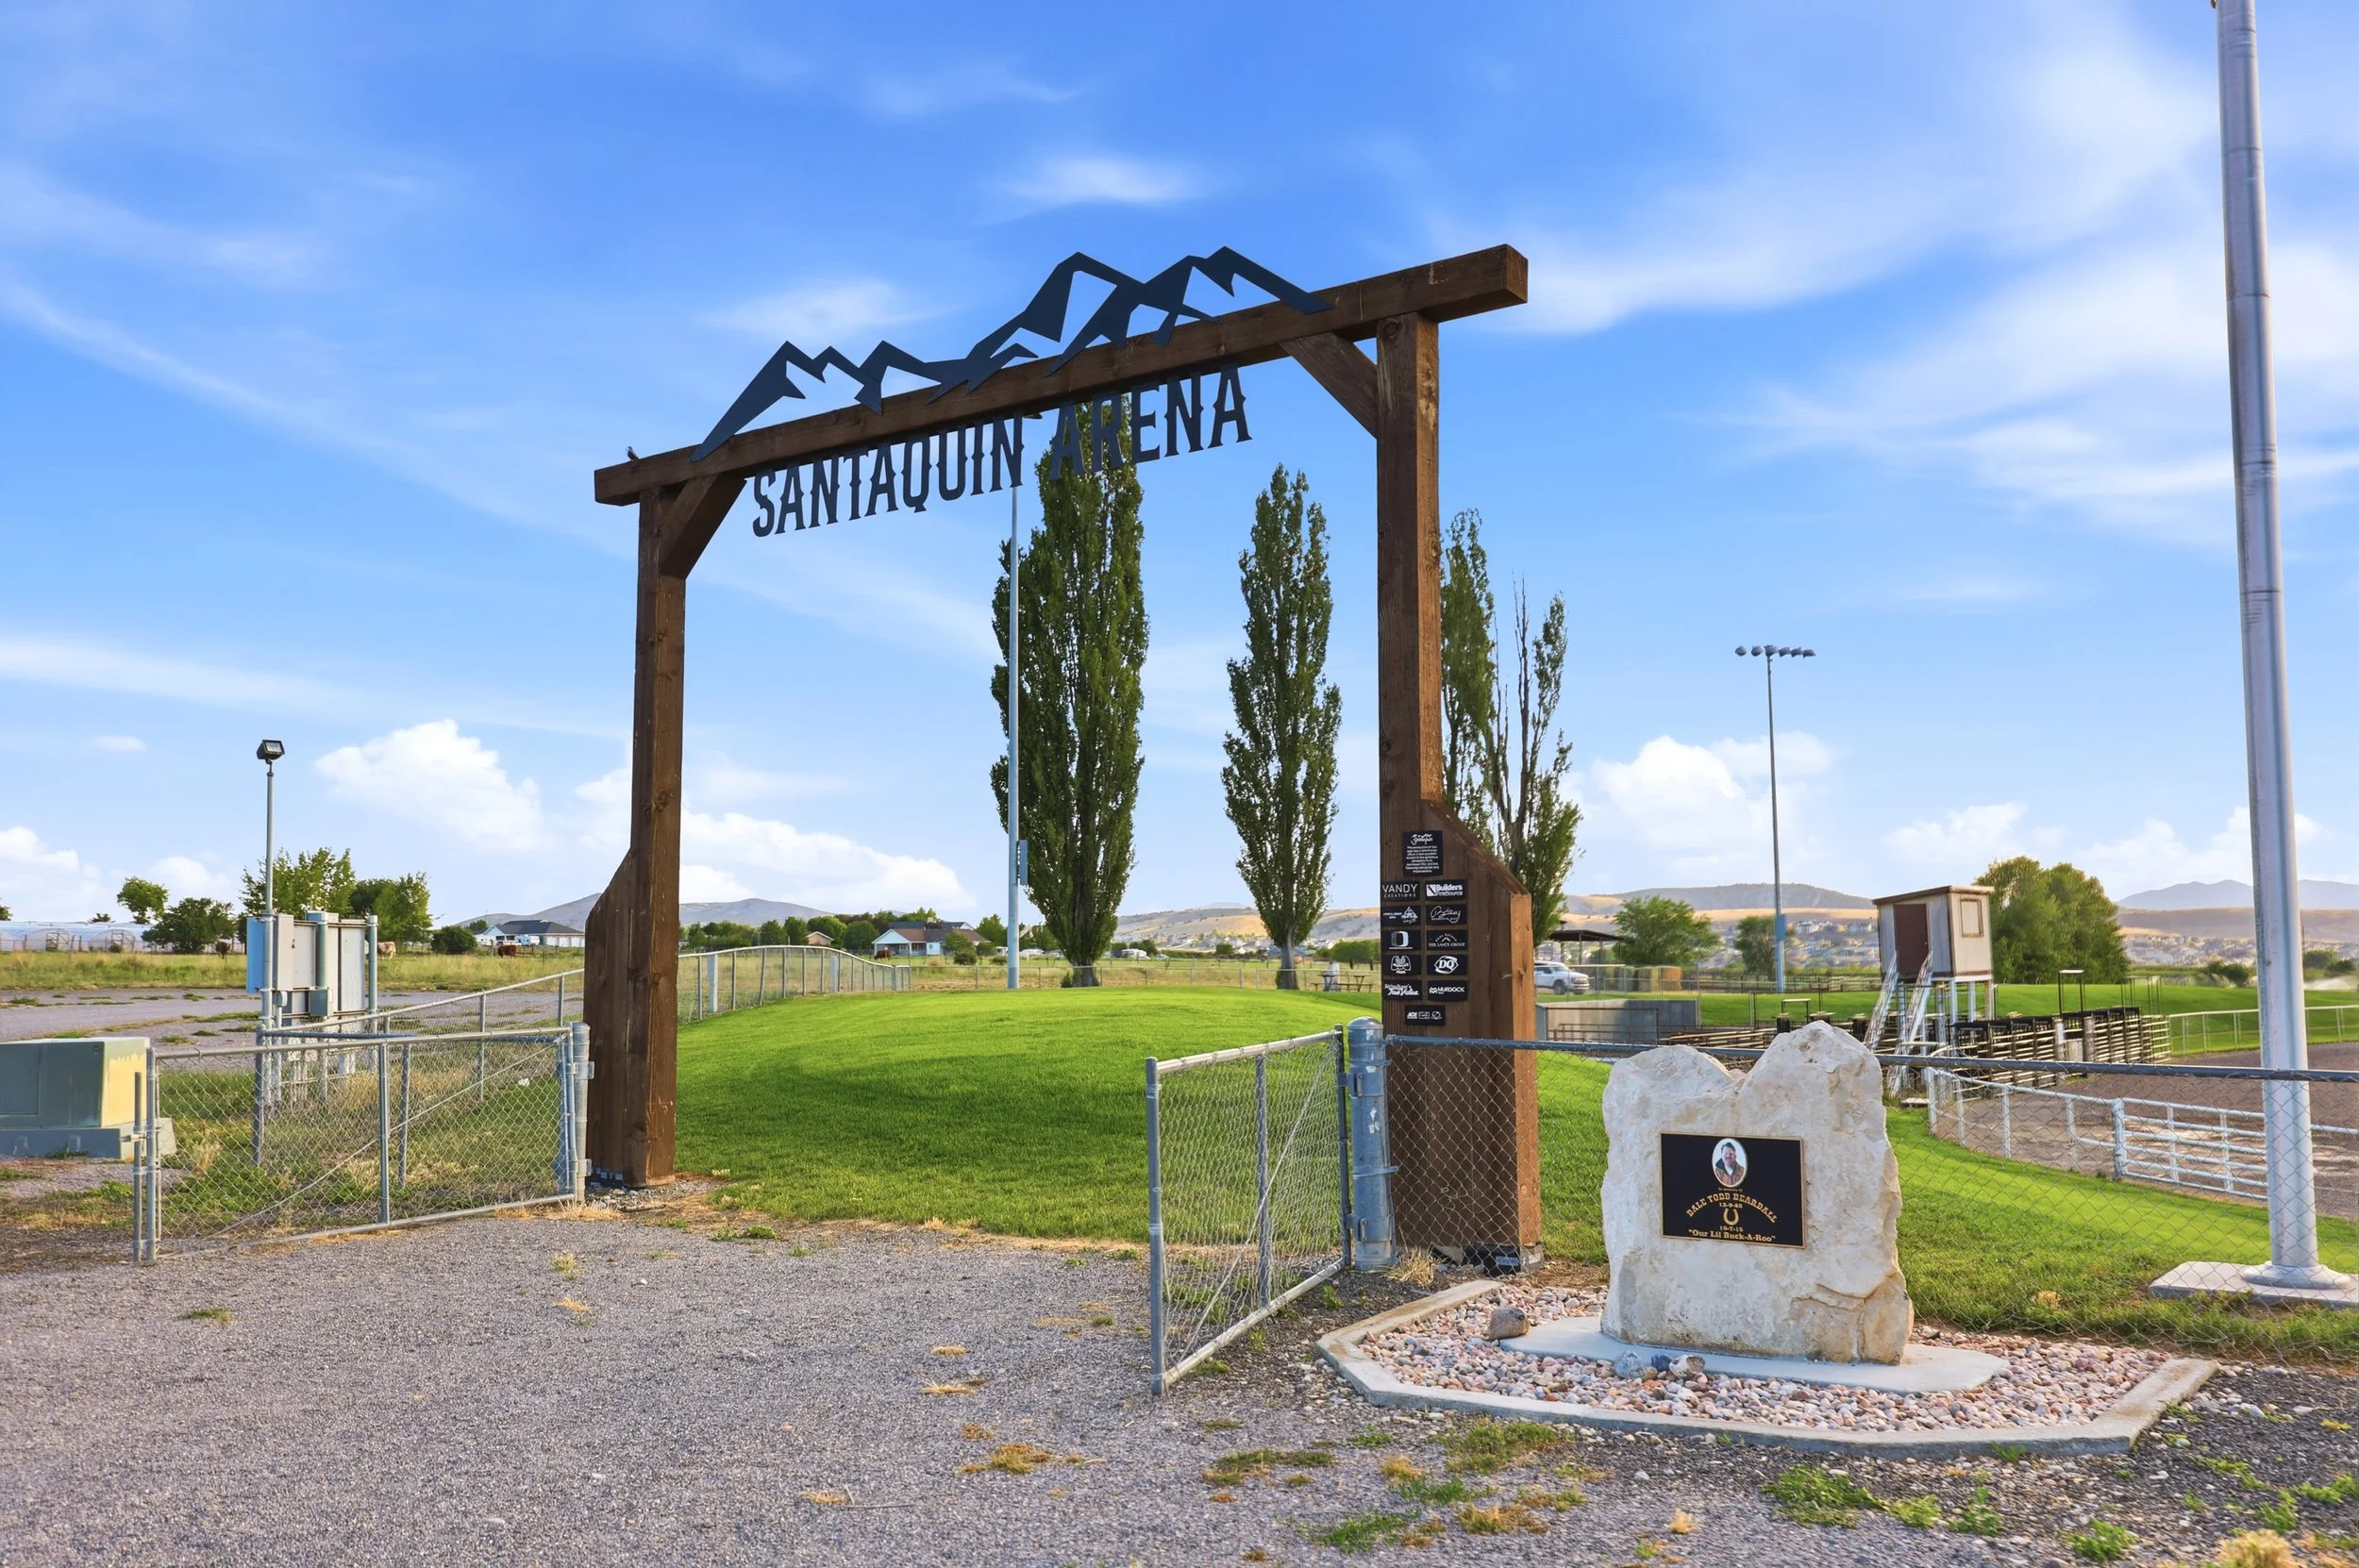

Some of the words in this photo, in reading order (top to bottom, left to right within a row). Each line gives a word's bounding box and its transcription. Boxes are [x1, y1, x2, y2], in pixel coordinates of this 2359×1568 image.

[752, 409, 1024, 538] SANTAQUIN
[1049, 363, 1253, 481] ARENA
[1381, 883, 1418, 893] VANDY
[1435, 883, 1464, 892] Builders
[1438, 959, 1455, 970] DQ
[1685, 1198, 1707, 1218] DALE
[1707, 1192, 1731, 1203] TODD
